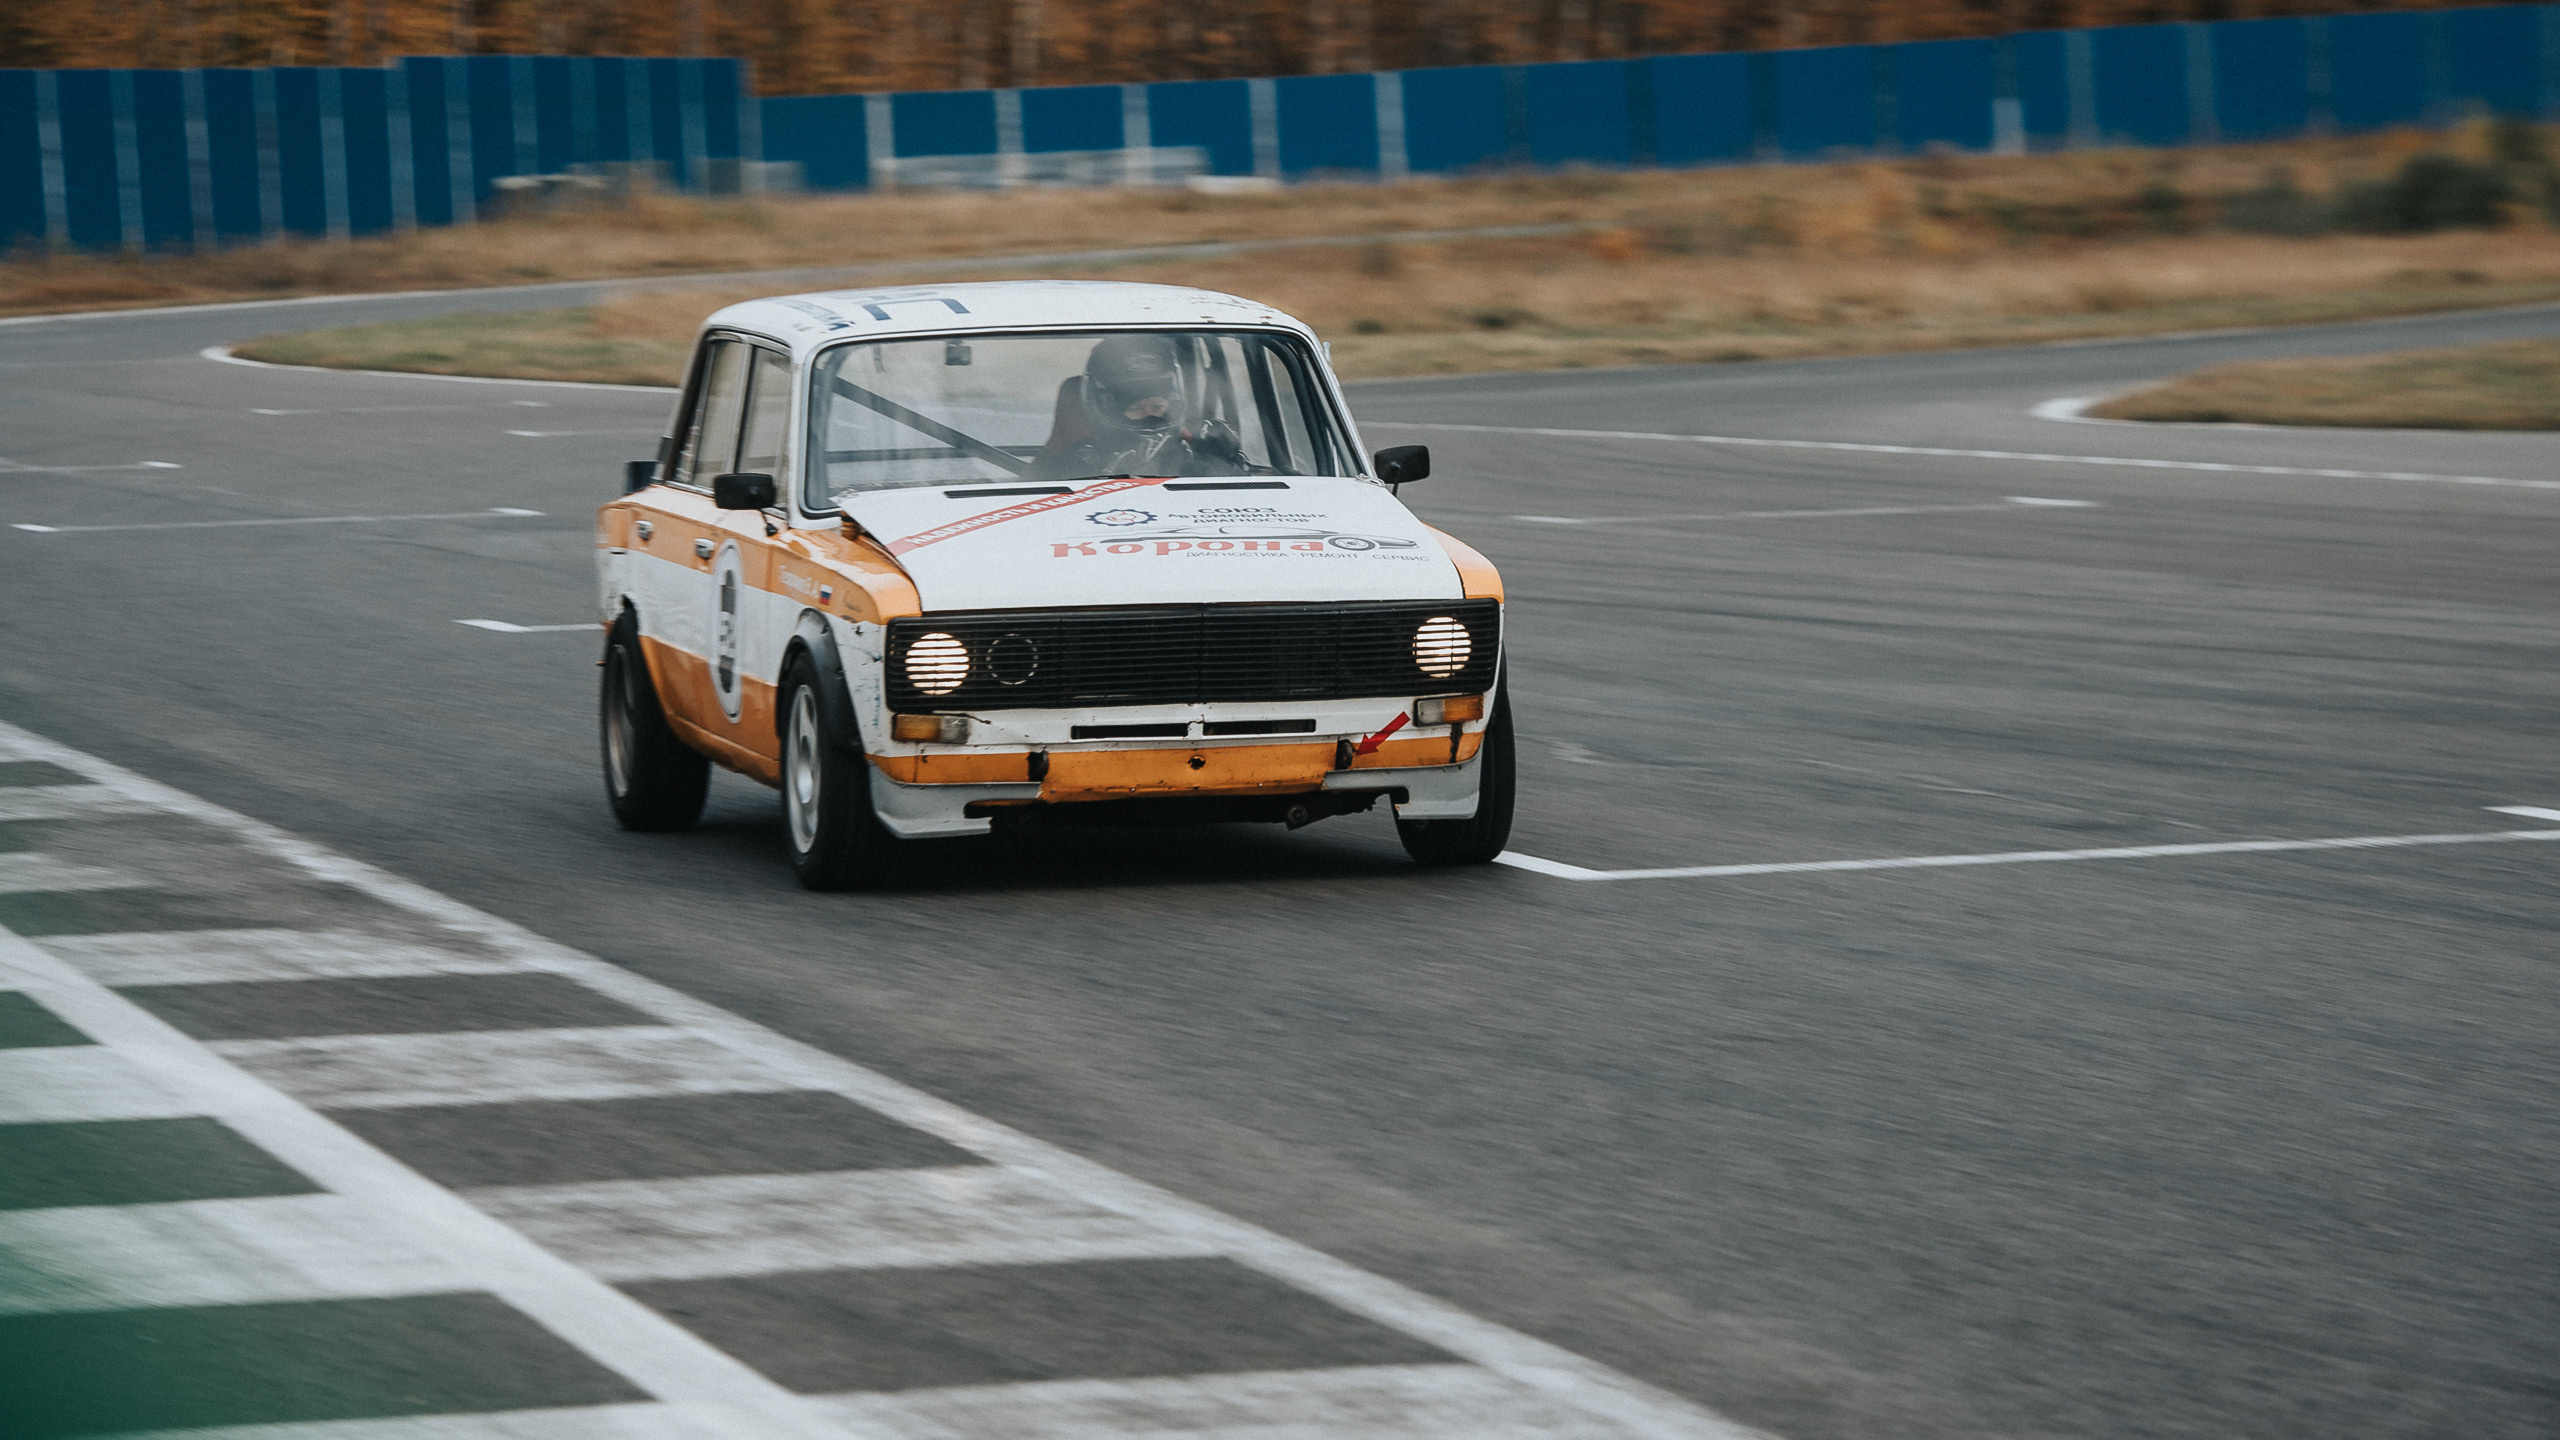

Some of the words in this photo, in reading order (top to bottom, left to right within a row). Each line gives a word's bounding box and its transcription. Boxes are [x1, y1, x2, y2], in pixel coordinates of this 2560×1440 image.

[904, 508, 1030, 545] НАДЕЖНОСТЬ
[1026, 503, 1042, 511] И
[1300, 552, 1359, 560] РЕМОНТ
[1372, 553, 1430, 562] СЕРВИС
